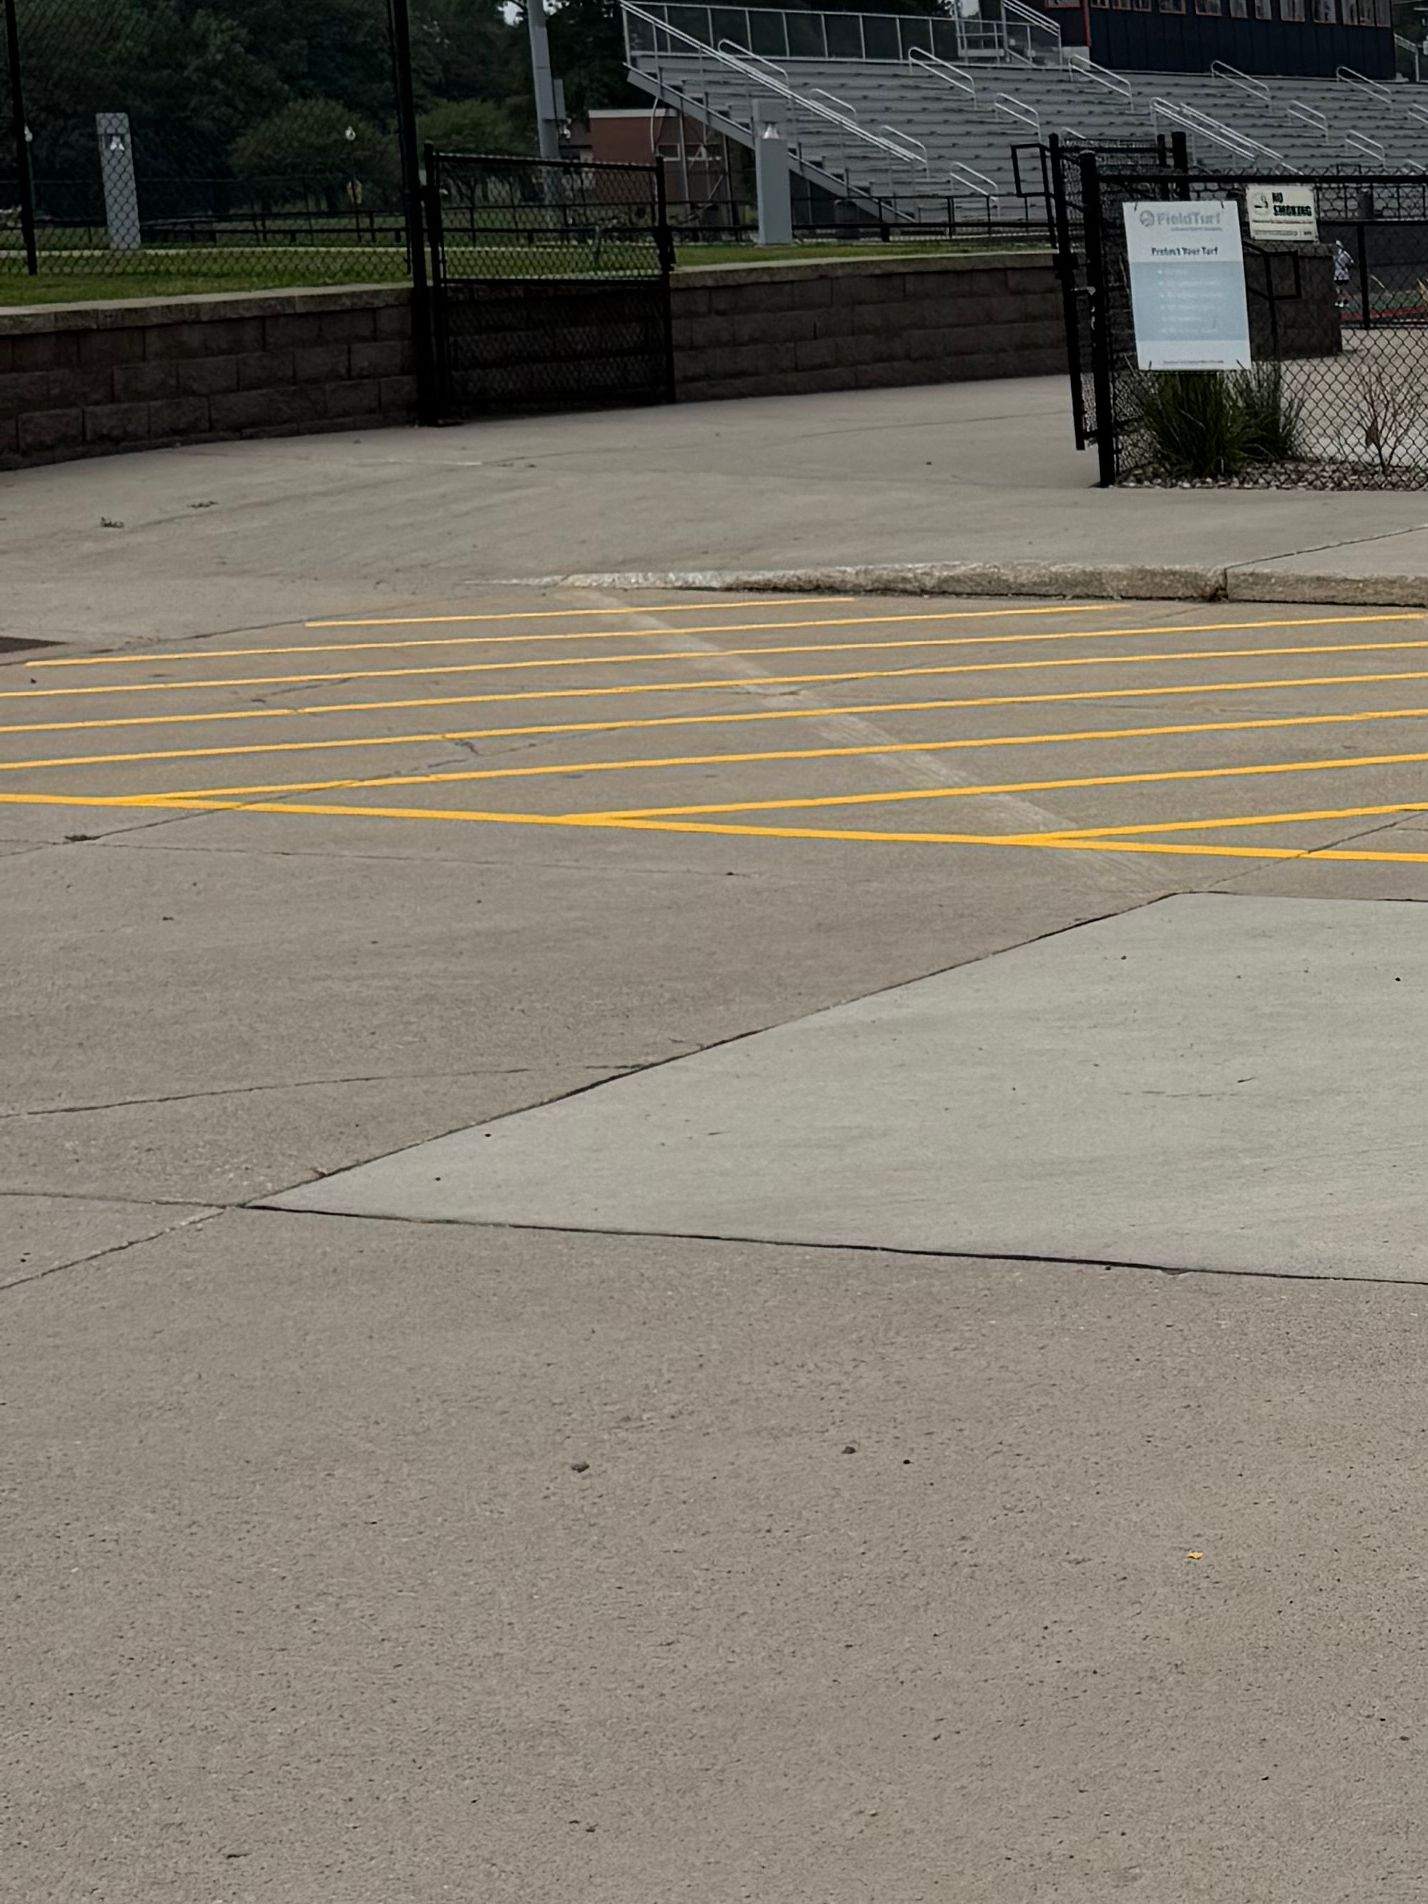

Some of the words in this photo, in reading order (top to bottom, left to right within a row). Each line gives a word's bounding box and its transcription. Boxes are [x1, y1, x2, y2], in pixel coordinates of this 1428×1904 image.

[1272, 192, 1284, 203] NO
[1156, 211, 1221, 226] FieldTurf
[1202, 246, 1219, 256] Turf
